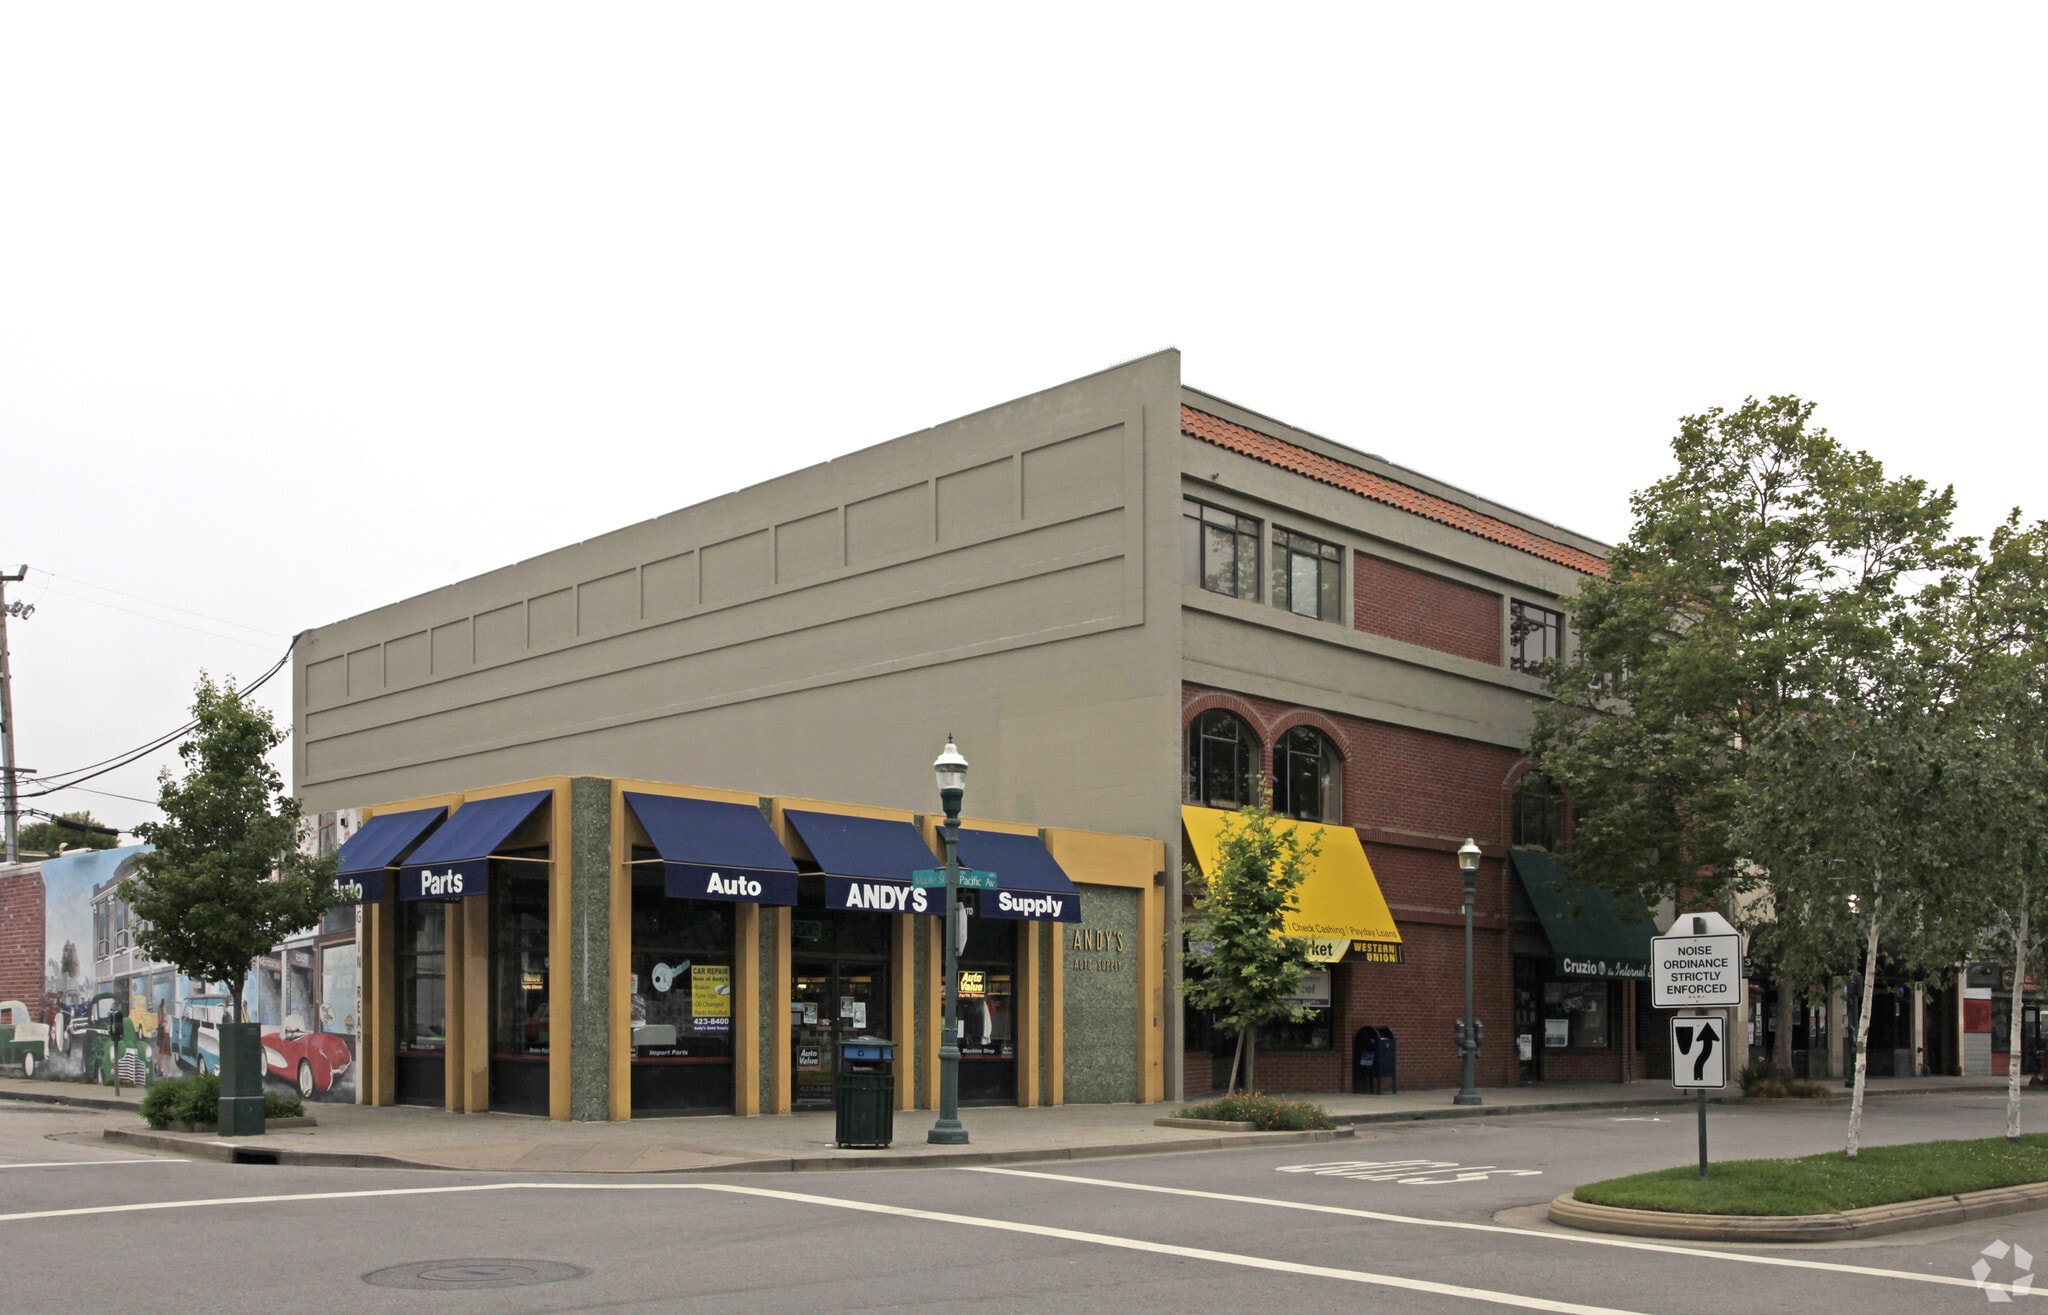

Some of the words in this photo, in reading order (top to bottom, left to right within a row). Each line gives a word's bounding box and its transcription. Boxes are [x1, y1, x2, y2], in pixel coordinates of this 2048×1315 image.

[421, 869, 463, 896] Parts
[706, 872, 762, 896] Auto
[915, 875, 935, 886] Maple
[959, 875, 982, 887] Pacific
[985, 878, 995, 887] Av
[846, 883, 928, 912] ANDY'S
[999, 891, 1063, 918] Supply
[1292, 922, 1315, 932] Check
[1315, 924, 1346, 936] Cashing
[1350, 927, 1375, 938] Payday
[1376, 928, 1397, 938] Loans
[1073, 929, 1124, 952] ANDY'S
[1312, 940, 1333, 956] ket
[1354, 942, 1395, 954] WESTERN
[1678, 946, 1712, 956] NOISE
[1367, 953, 1396, 962] UNION
[1073, 959, 1092, 971] AUTO
[1097, 960, 1122, 972] SUPPLY
[1563, 957, 1597, 975] Cruzio
[1615, 961, 1646, 977] Internet
[1663, 958, 1729, 970] ORDINANCE
[962, 972, 983, 982] Auto
[1671, 971, 1721, 982] STRICTLY
[960, 981, 983, 992] Value
[1666, 984, 1727, 995] ENFORCED
[800, 1049, 818, 1057] Auto
[799, 1057, 819, 1065] Value
